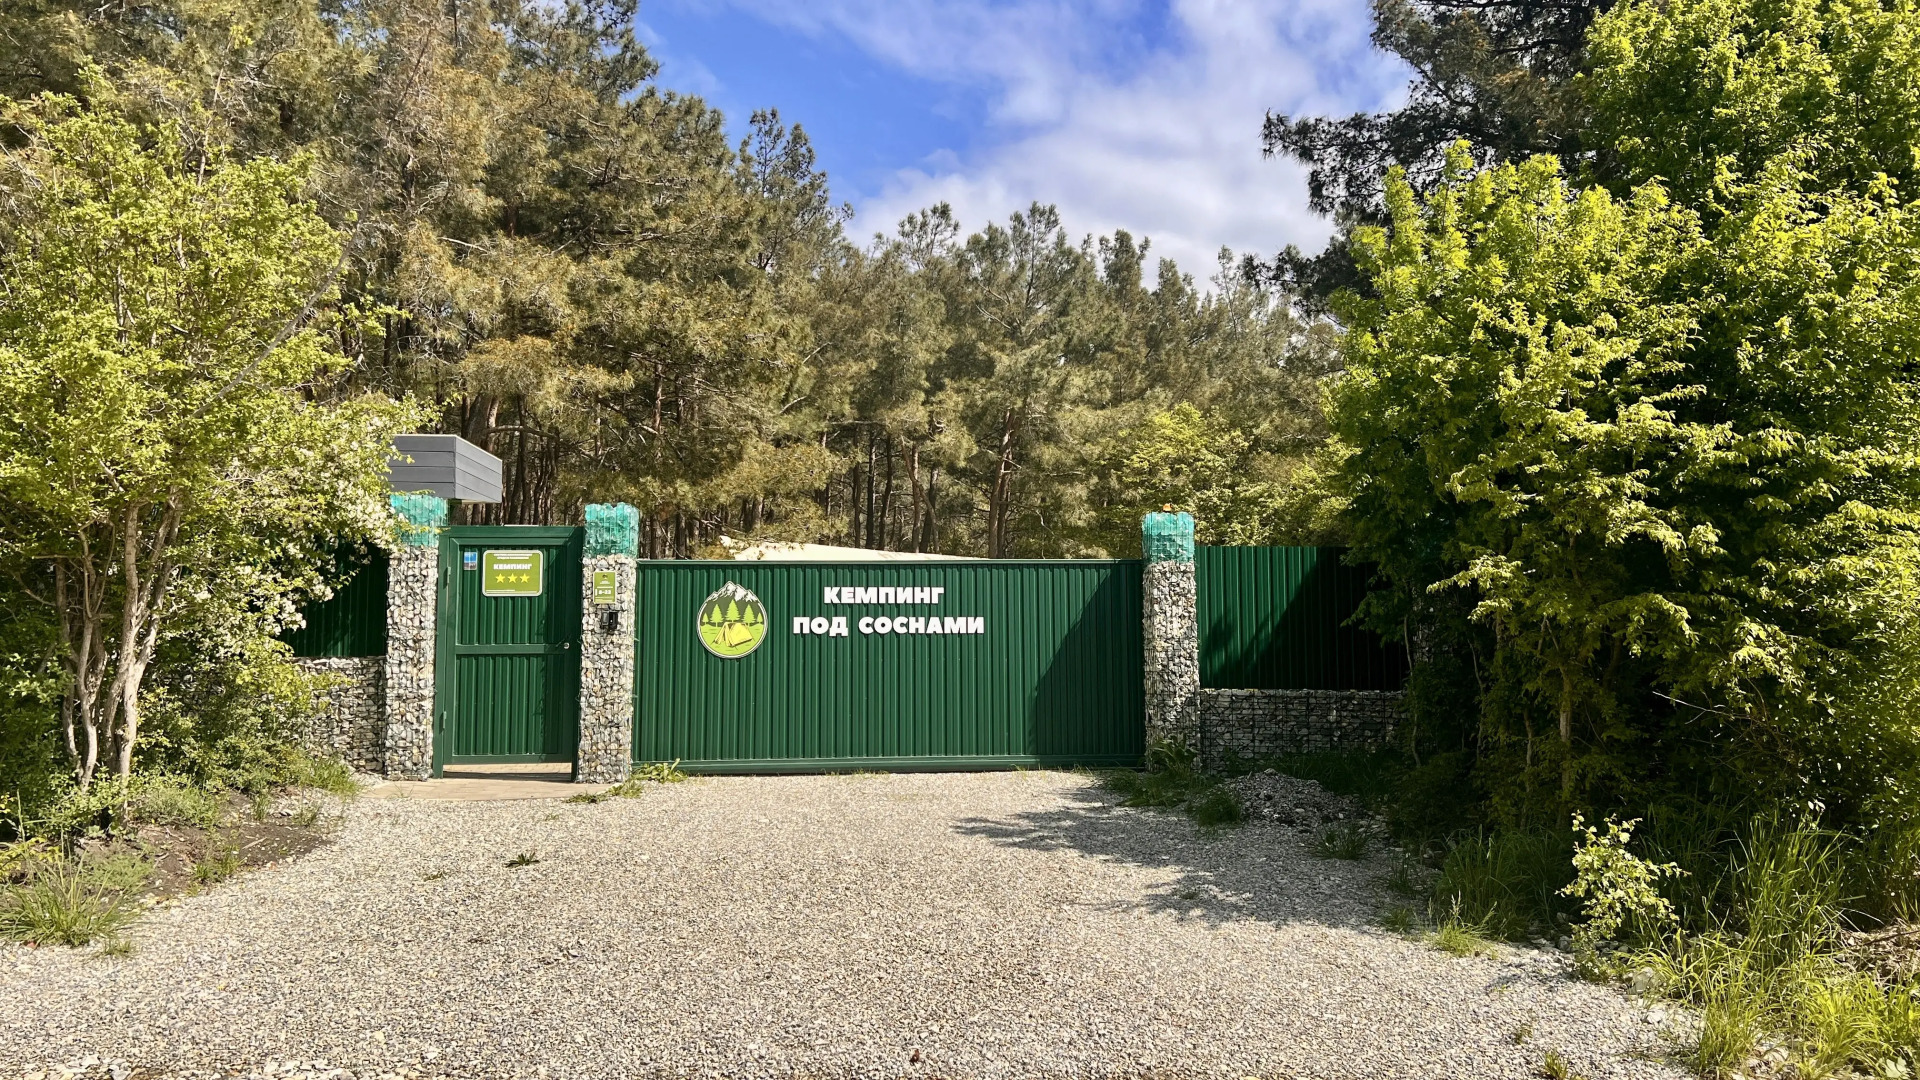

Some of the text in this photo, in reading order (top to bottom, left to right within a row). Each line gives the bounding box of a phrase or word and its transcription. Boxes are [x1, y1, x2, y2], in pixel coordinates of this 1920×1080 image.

[824, 587, 944, 604] КЕМПИНГ
[793, 616, 985, 637] ПОД СОСНАМИ
